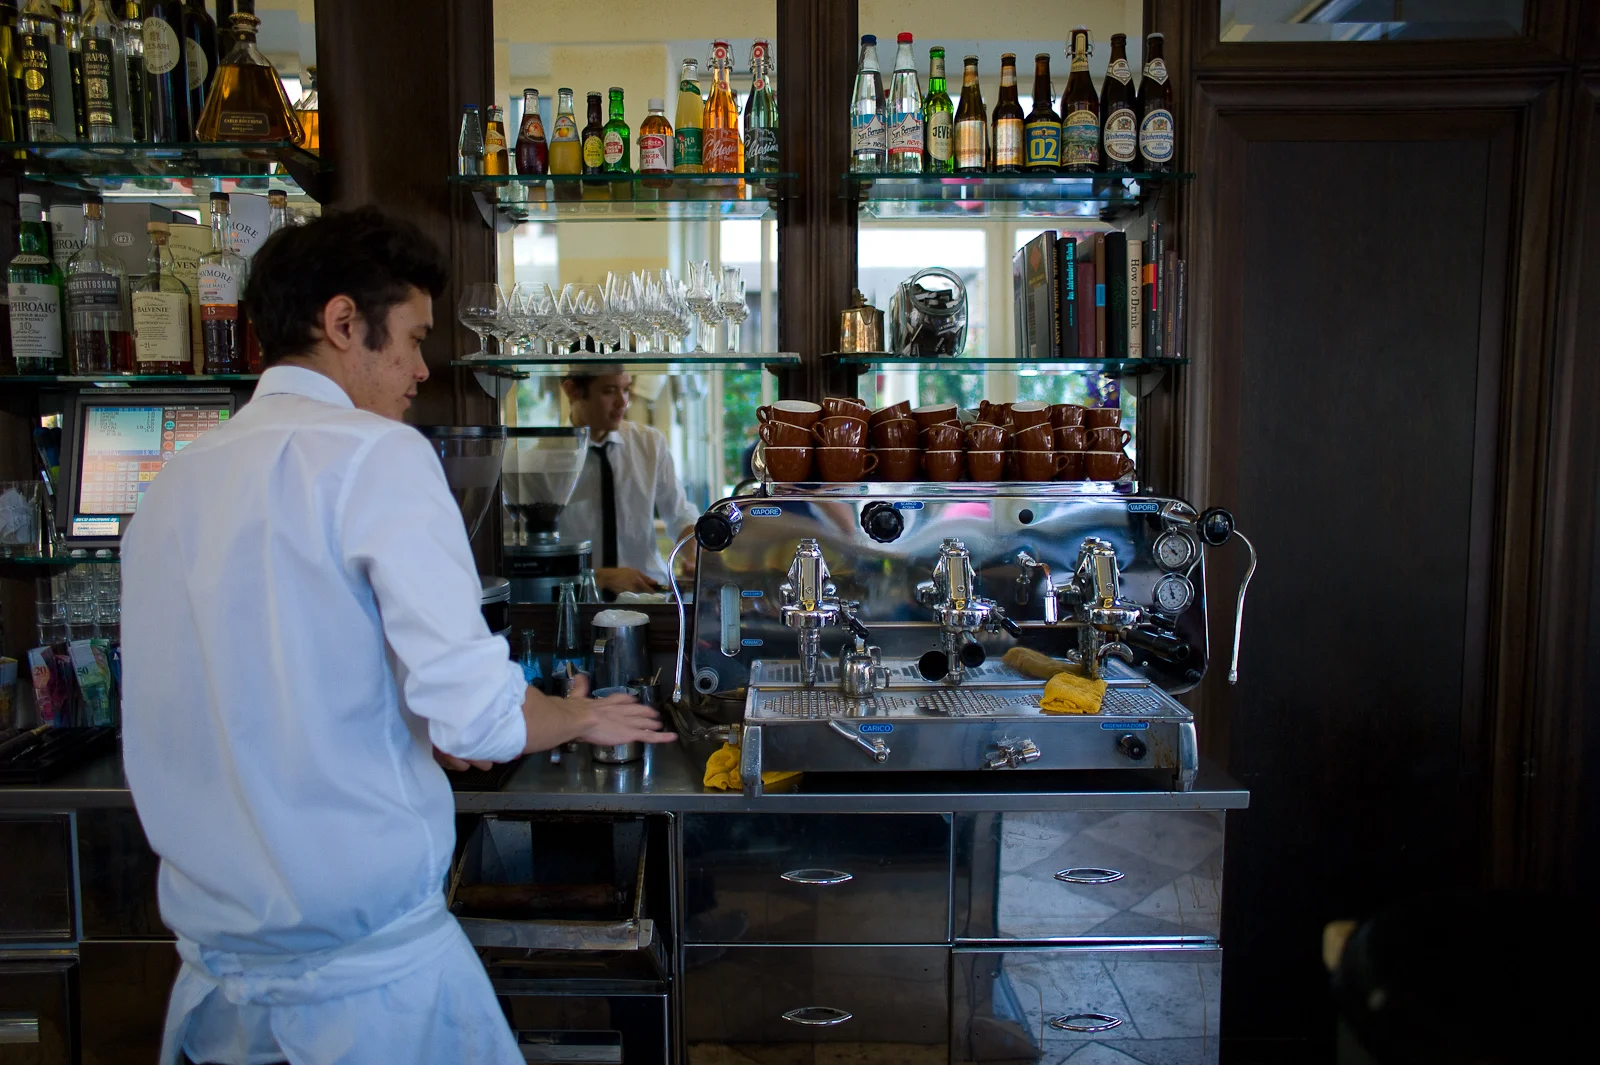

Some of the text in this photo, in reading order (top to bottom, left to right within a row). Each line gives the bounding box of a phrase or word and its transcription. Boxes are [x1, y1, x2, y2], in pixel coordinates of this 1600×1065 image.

[1030, 138, 1057, 160] 02
[1131, 259, 1139, 329] How to Drink
[19, 322, 32, 330] 10
[34, 666, 47, 676] 20
[78, 667, 89, 676] 50
